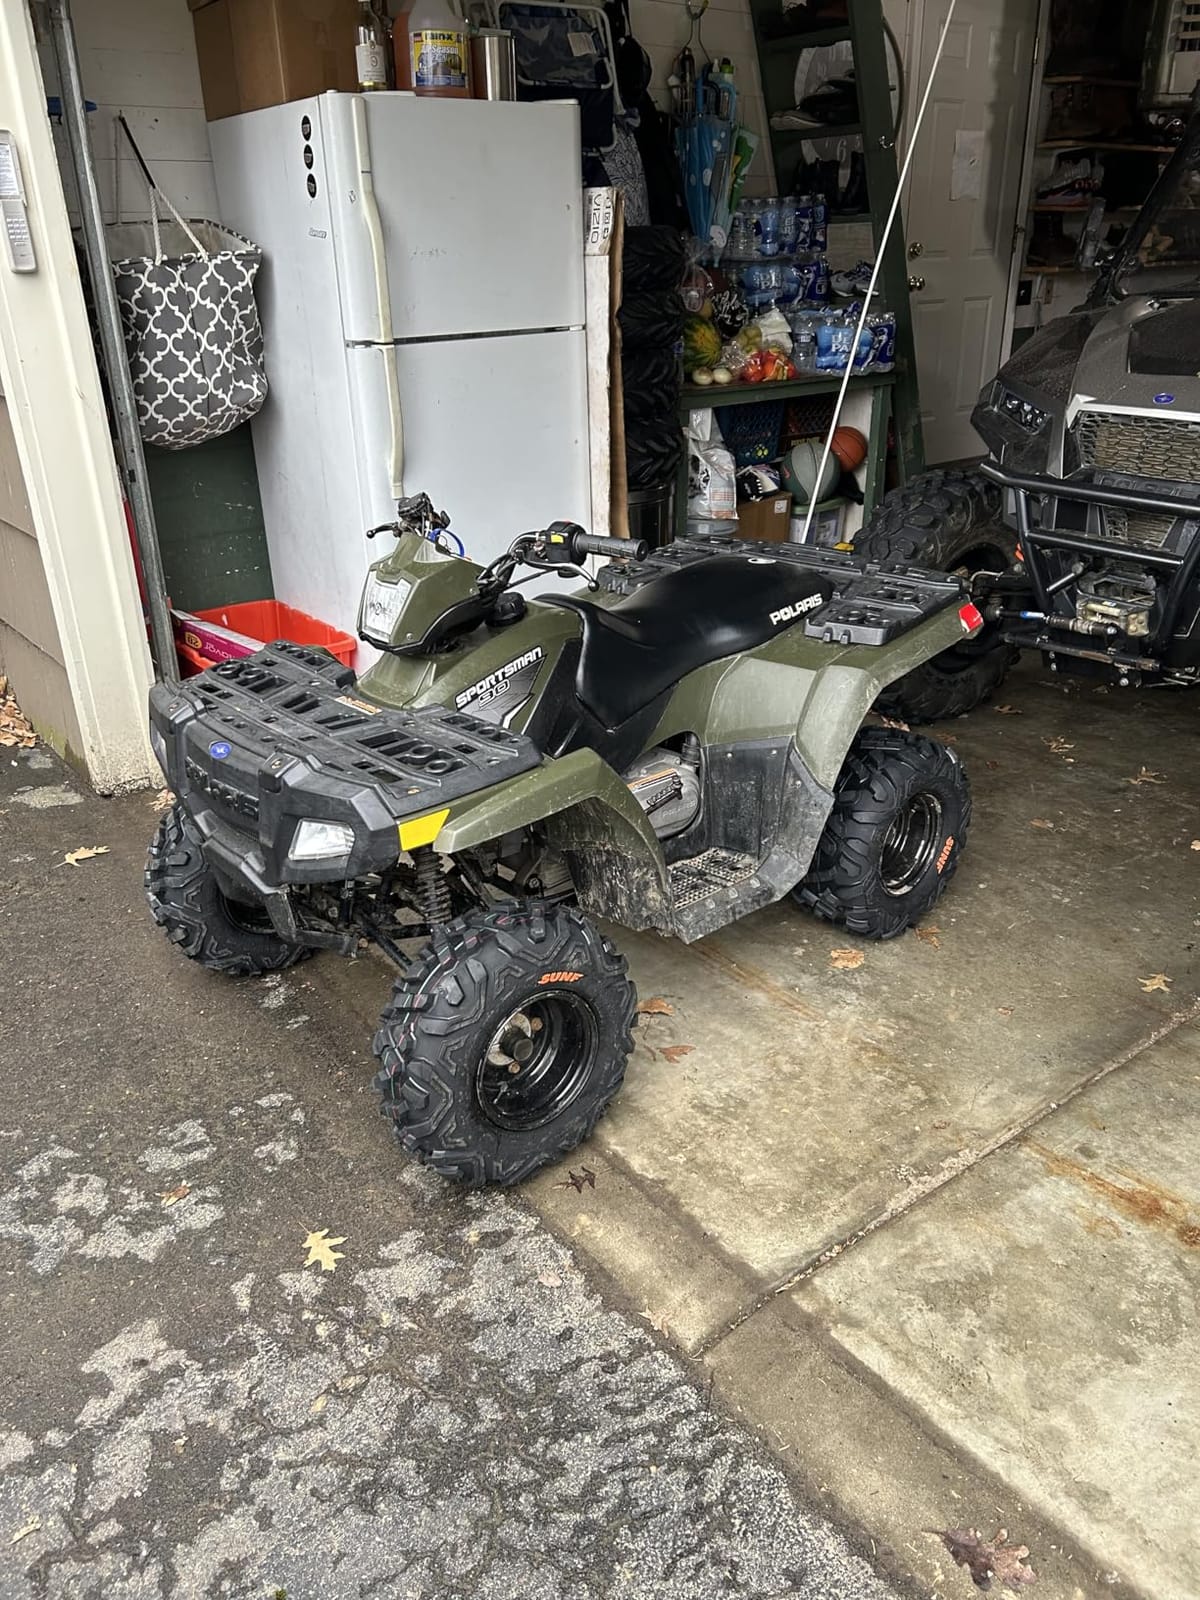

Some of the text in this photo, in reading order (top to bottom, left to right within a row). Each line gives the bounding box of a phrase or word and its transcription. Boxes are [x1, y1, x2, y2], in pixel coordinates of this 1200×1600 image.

[591, 194, 602, 244] VIZIO
[769, 593, 823, 625] POLARIS
[455, 646, 542, 709] SPORTSMAN
[478, 679, 510, 709] 90
[936, 836, 954, 875] SUNF
[537, 971, 584, 985] SUNF
